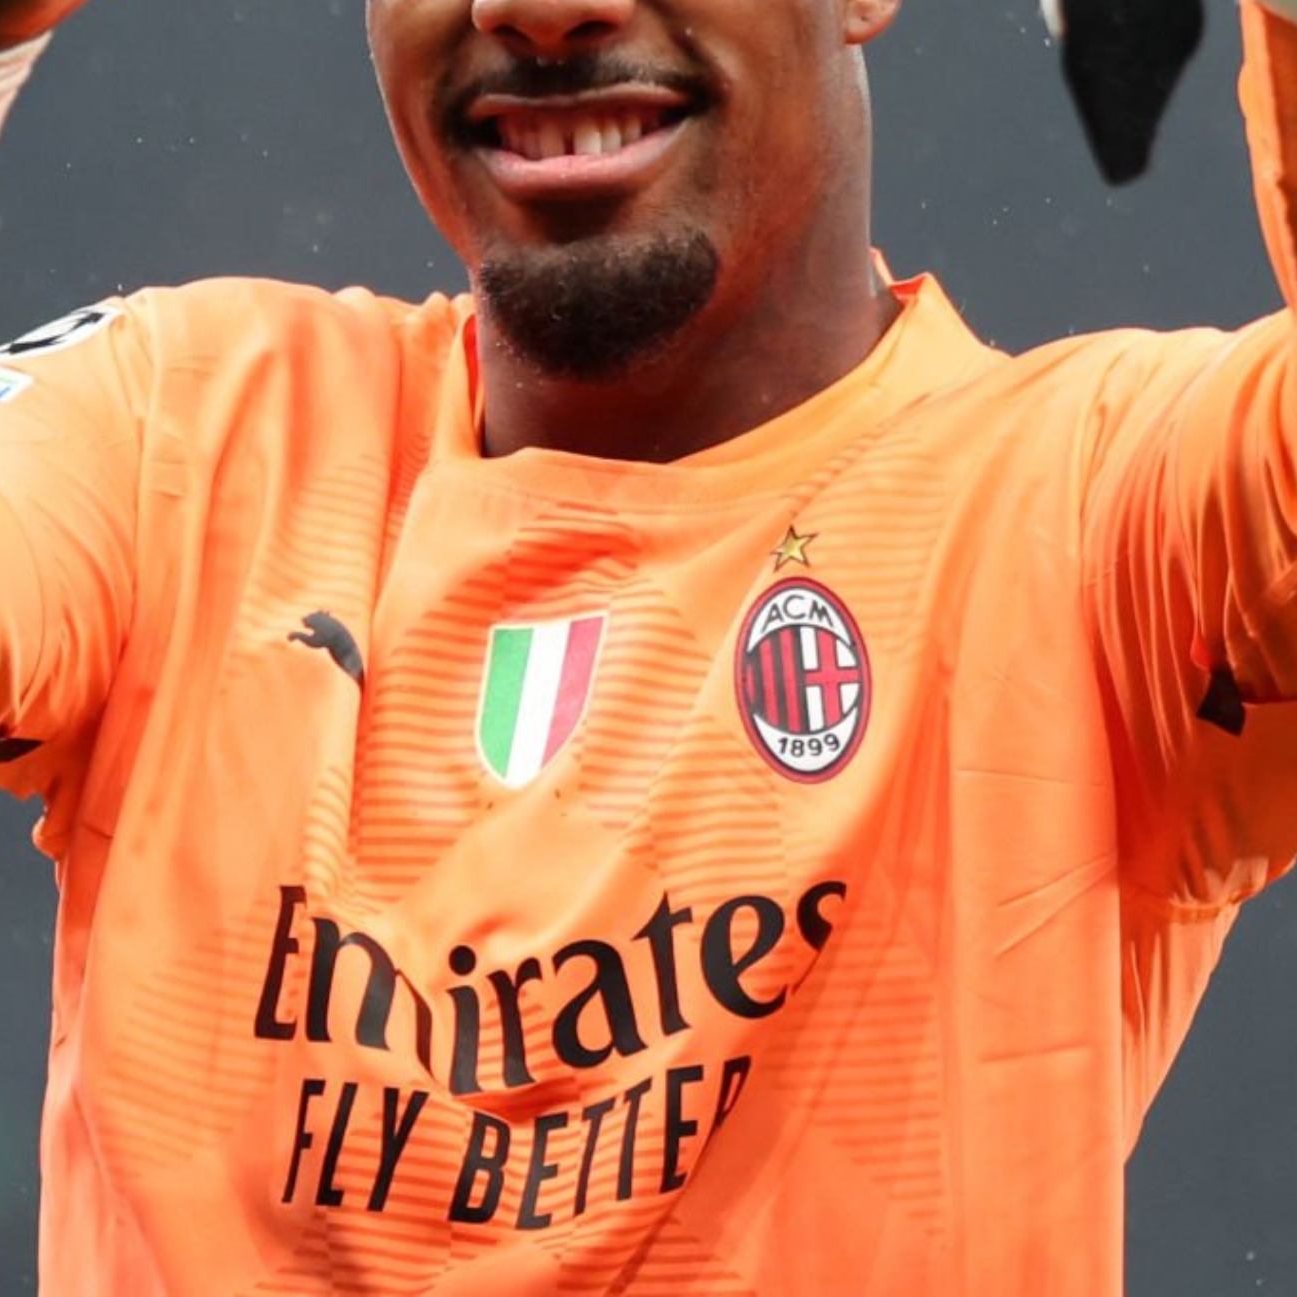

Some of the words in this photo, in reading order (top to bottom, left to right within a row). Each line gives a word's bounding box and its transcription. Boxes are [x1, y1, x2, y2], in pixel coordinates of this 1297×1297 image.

[761, 594, 834, 634] ACM
[777, 733, 841, 758] 1899
[254, 880, 847, 1097] Emirates
[281, 1078, 429, 1213] FLY
